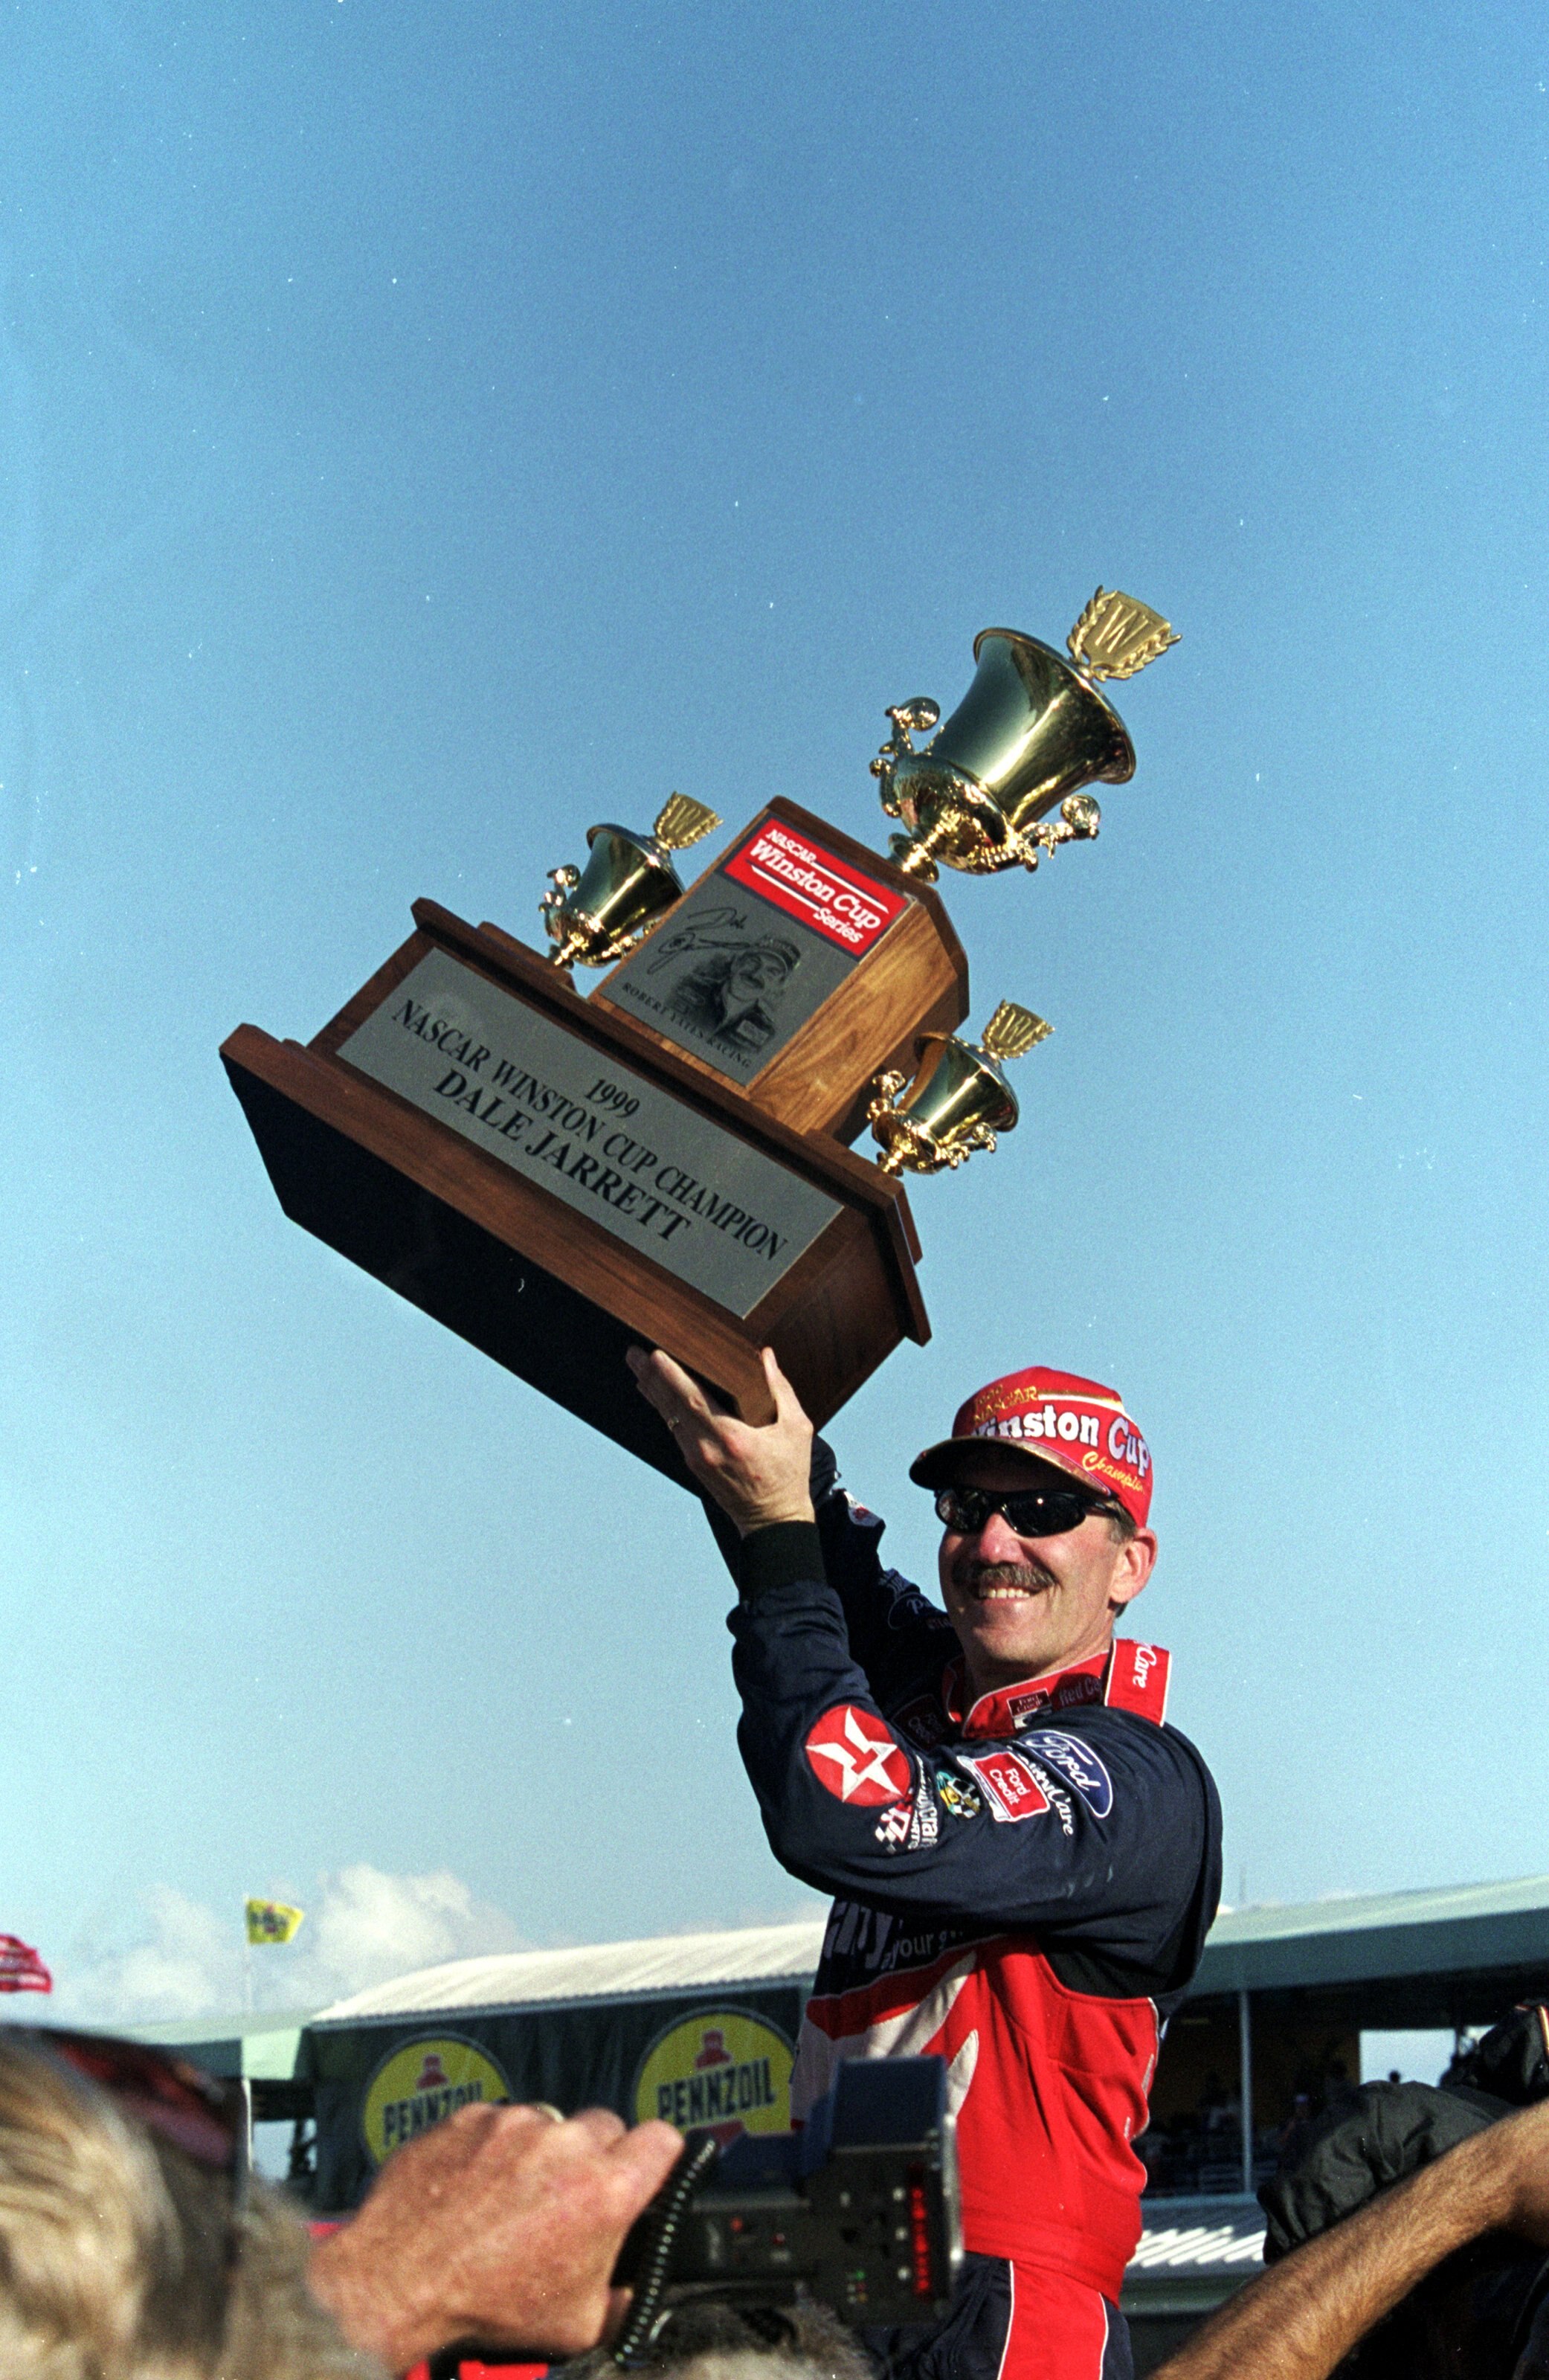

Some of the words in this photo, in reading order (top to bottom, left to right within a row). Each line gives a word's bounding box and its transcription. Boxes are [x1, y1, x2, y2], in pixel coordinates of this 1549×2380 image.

[765, 829, 817, 865] NASCAR
[749, 839, 835, 901] Winston
[832, 892, 881, 930] Cup
[813, 907, 863, 943] Series
[585, 1078, 641, 1119] 1999
[391, 999, 492, 1073] NASCAR
[492, 1058, 608, 1144] WINSTON
[603, 1132, 659, 1174] CUP
[654, 1165, 789, 1261] CHAMPION
[434, 1068, 534, 1141] DALE
[524, 1132, 692, 1242] JARRETT
[1107, 1415, 1150, 1478] Cup
[1132, 1644, 1158, 1689] Care
[989, 1768, 1021, 1806] Credit
[1005, 1767, 1031, 1796] Ford
[1025, 1734, 1102, 1793] Ford
[657, 2057, 776, 2126] PENNZOIL
